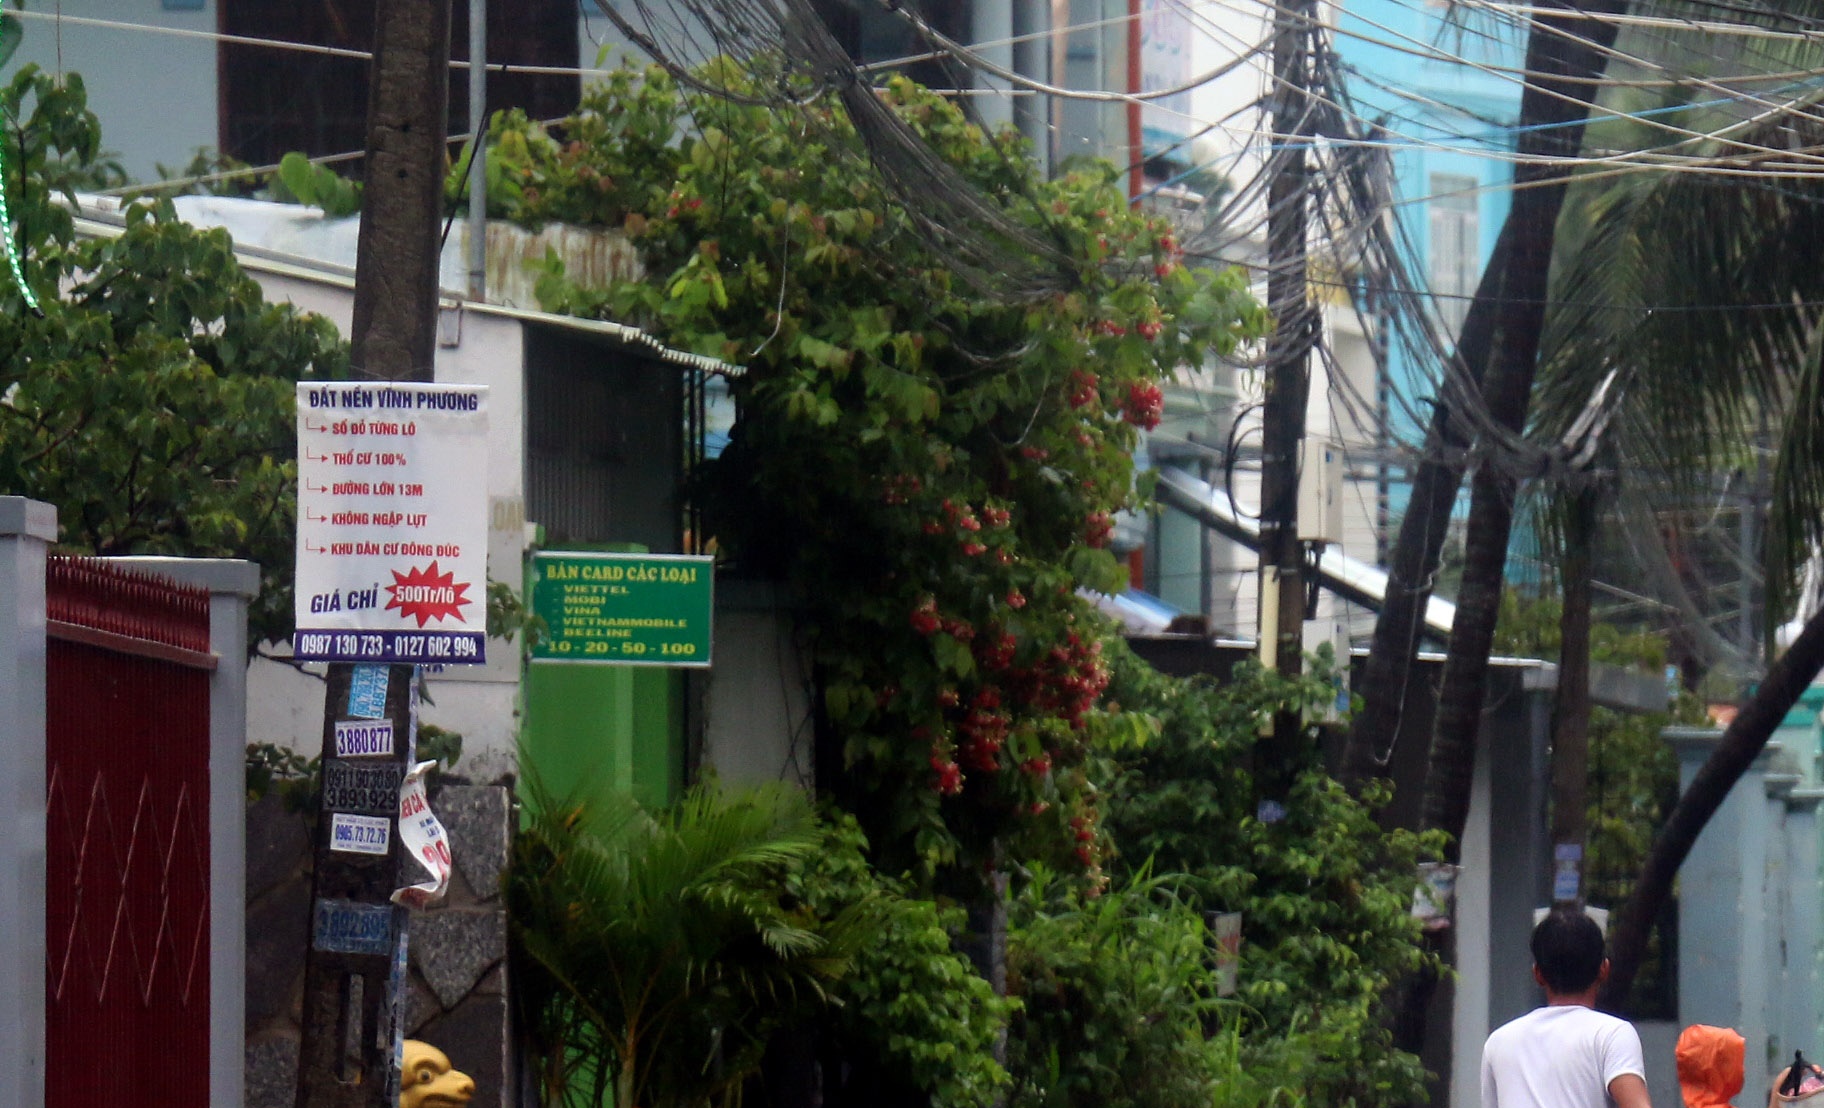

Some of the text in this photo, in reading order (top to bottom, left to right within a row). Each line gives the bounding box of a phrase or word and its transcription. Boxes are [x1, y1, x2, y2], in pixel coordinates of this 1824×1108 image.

[309, 384, 478, 411] ĐẤT NỀN VĨNH PHƯƠNG
[402, 421, 416, 436] LÔ
[356, 452, 372, 465] CƯ
[376, 453, 407, 466] 100%
[373, 480, 395, 496] LỚN
[399, 483, 423, 496] 13M
[331, 511, 428, 529] KHÔNG NGẬP LỤT
[331, 540, 460, 558] KHU DÂN CƯ ĐÔNG ĐÚC
[547, 561, 697, 585] BÁN CARD CÁC LOẠI
[564, 584, 631, 595] VIETTEL
[310, 588, 341, 614] GIÁ
[564, 596, 606, 605] MOBI
[564, 606, 601, 615] VINA
[563, 617, 688, 628] VIETNAMMOBILE
[564, 628, 632, 638] BEELINE
[301, 634, 331, 655] 0987
[336, 634, 357, 655] 130
[361, 635, 383, 656] 733
[395, 635, 425, 656] 0127
[428, 636, 451, 656] 602
[454, 636, 477, 657] 994
[549, 641, 571, 653] 10
[585, 641, 608, 653] 20
[622, 641, 646, 654] 50
[661, 643, 696, 655] 100
